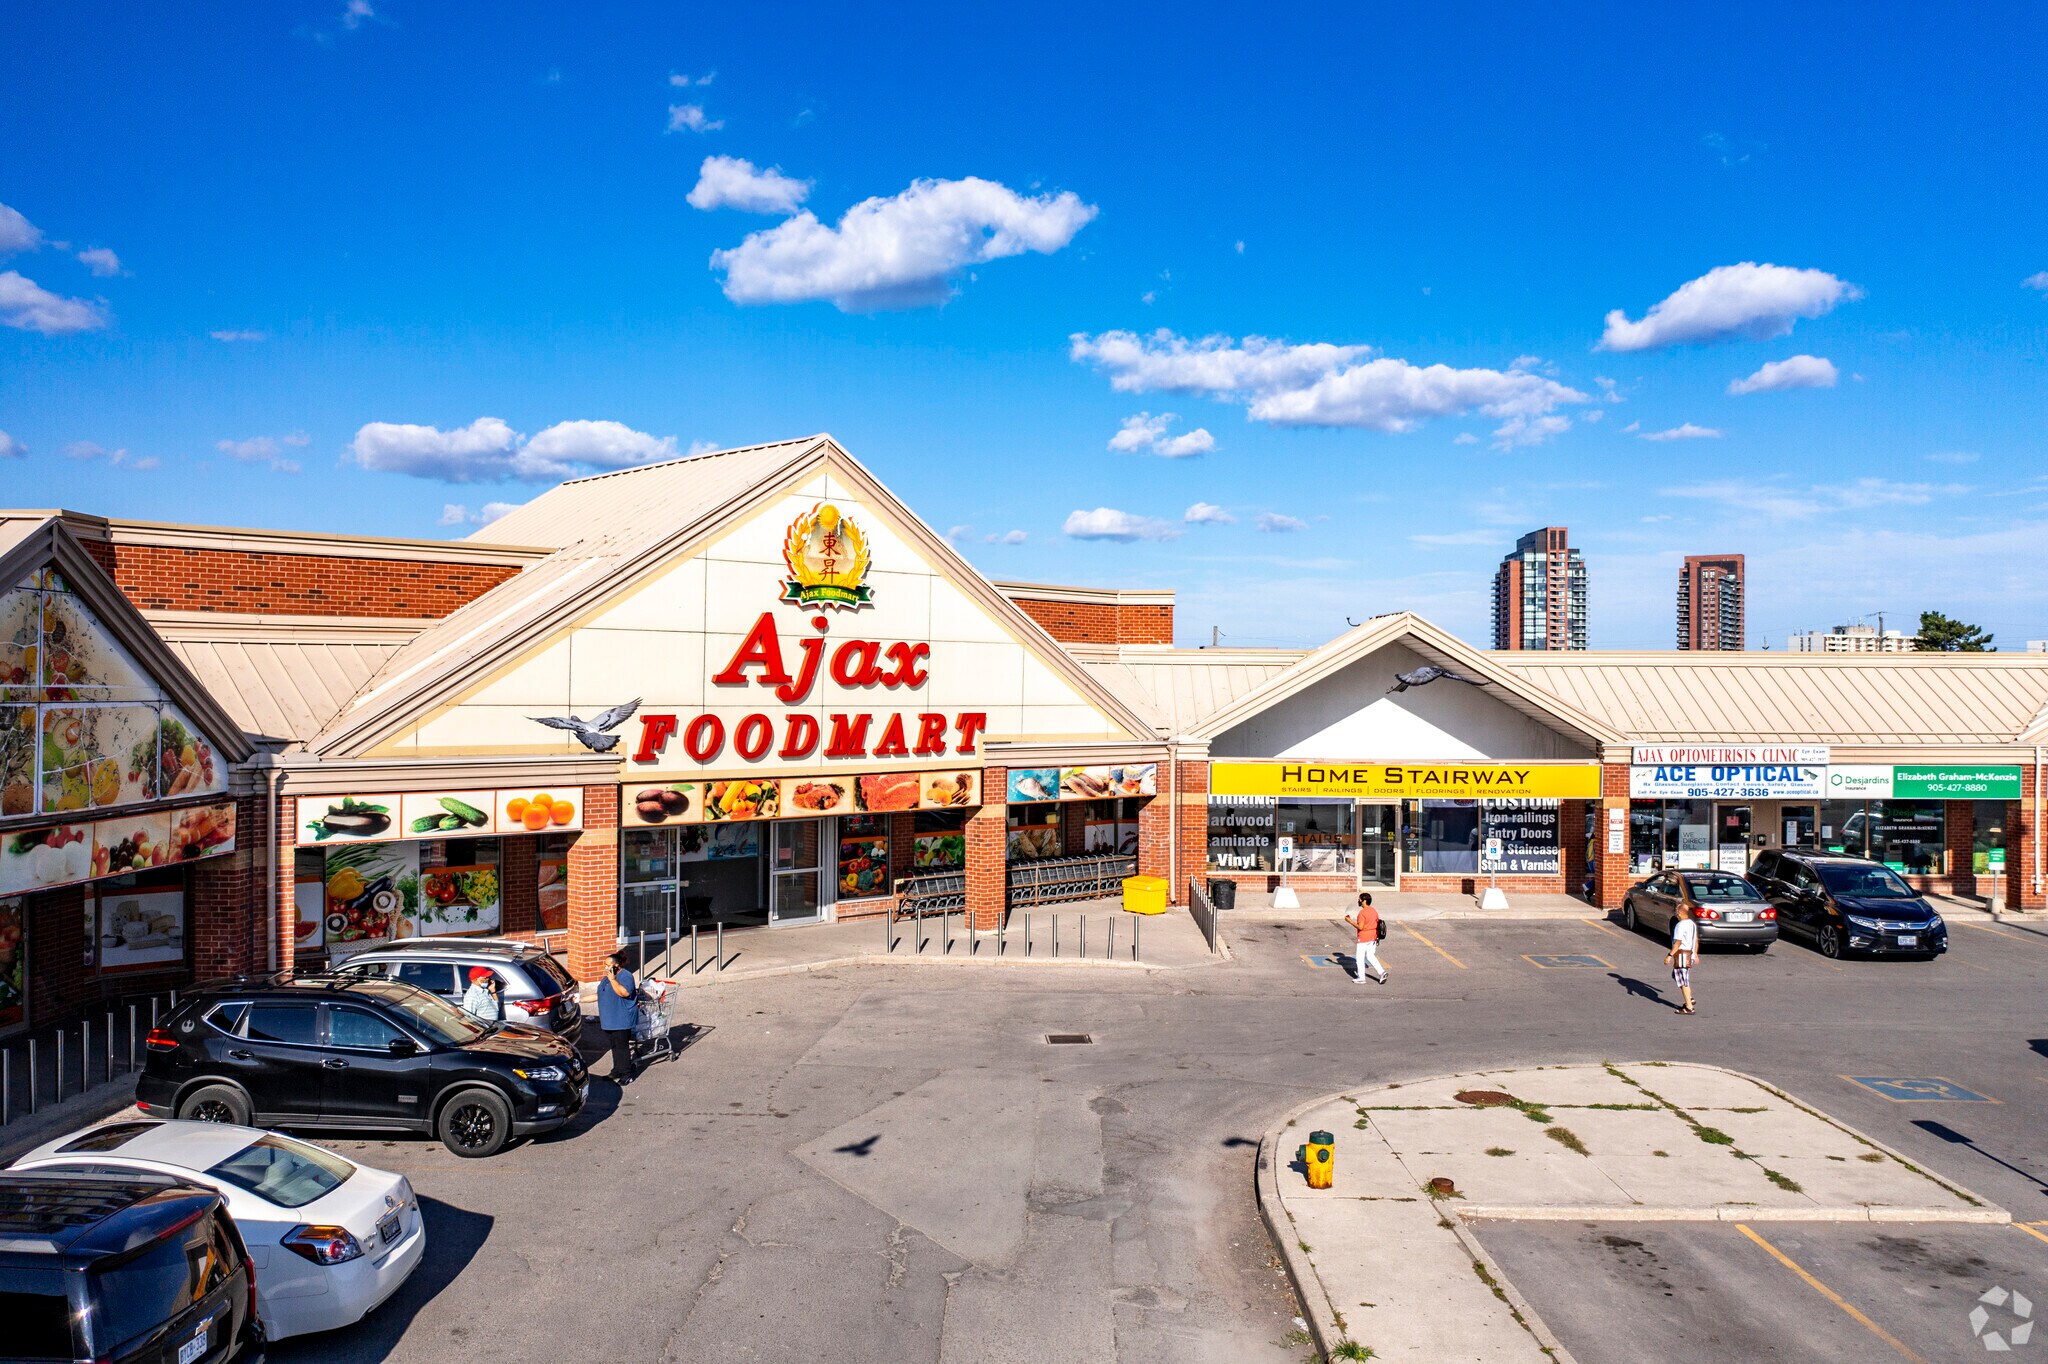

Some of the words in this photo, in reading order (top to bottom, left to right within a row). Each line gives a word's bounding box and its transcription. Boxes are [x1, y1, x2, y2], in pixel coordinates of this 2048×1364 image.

[819, 531, 841, 585] 東昇
[800, 588, 819, 601] Ajax
[820, 586, 859, 602] Foodmart
[711, 611, 930, 703] Ajax
[632, 711, 987, 762] FOODMART
[1636, 748, 1664, 763] AJAX
[1670, 748, 1757, 763] OPTOMETRISTS
[1762, 748, 1800, 763] CLINIC
[1282, 765, 1368, 783] HOME
[1384, 767, 1530, 785] STAIRWAY
[1654, 765, 1696, 782] ACE
[1711, 765, 1804, 782] OPTICAL
[1845, 776, 1890, 785] Desjardins
[1897, 772, 1937, 781] Elizabeth
[1938, 772, 2018, 782] Graham-McKenzie
[1687, 787, 1769, 798] 905-427-3636
[1927, 783, 1988, 792] 905-427-8880
[1485, 811, 1508, 823] Iron
[1512, 811, 1556, 826] railings
[1208, 833, 1270, 847] aminate
[1488, 827, 1517, 841] Entry
[1520, 827, 1553, 839] Doors
[1507, 843, 1559, 855] Staircase
[1217, 853, 1257, 870] Vinyl
[1481, 859, 1507, 871] Stain
[1509, 859, 1519, 871] &
[1520, 859, 1559, 871] Varnish
